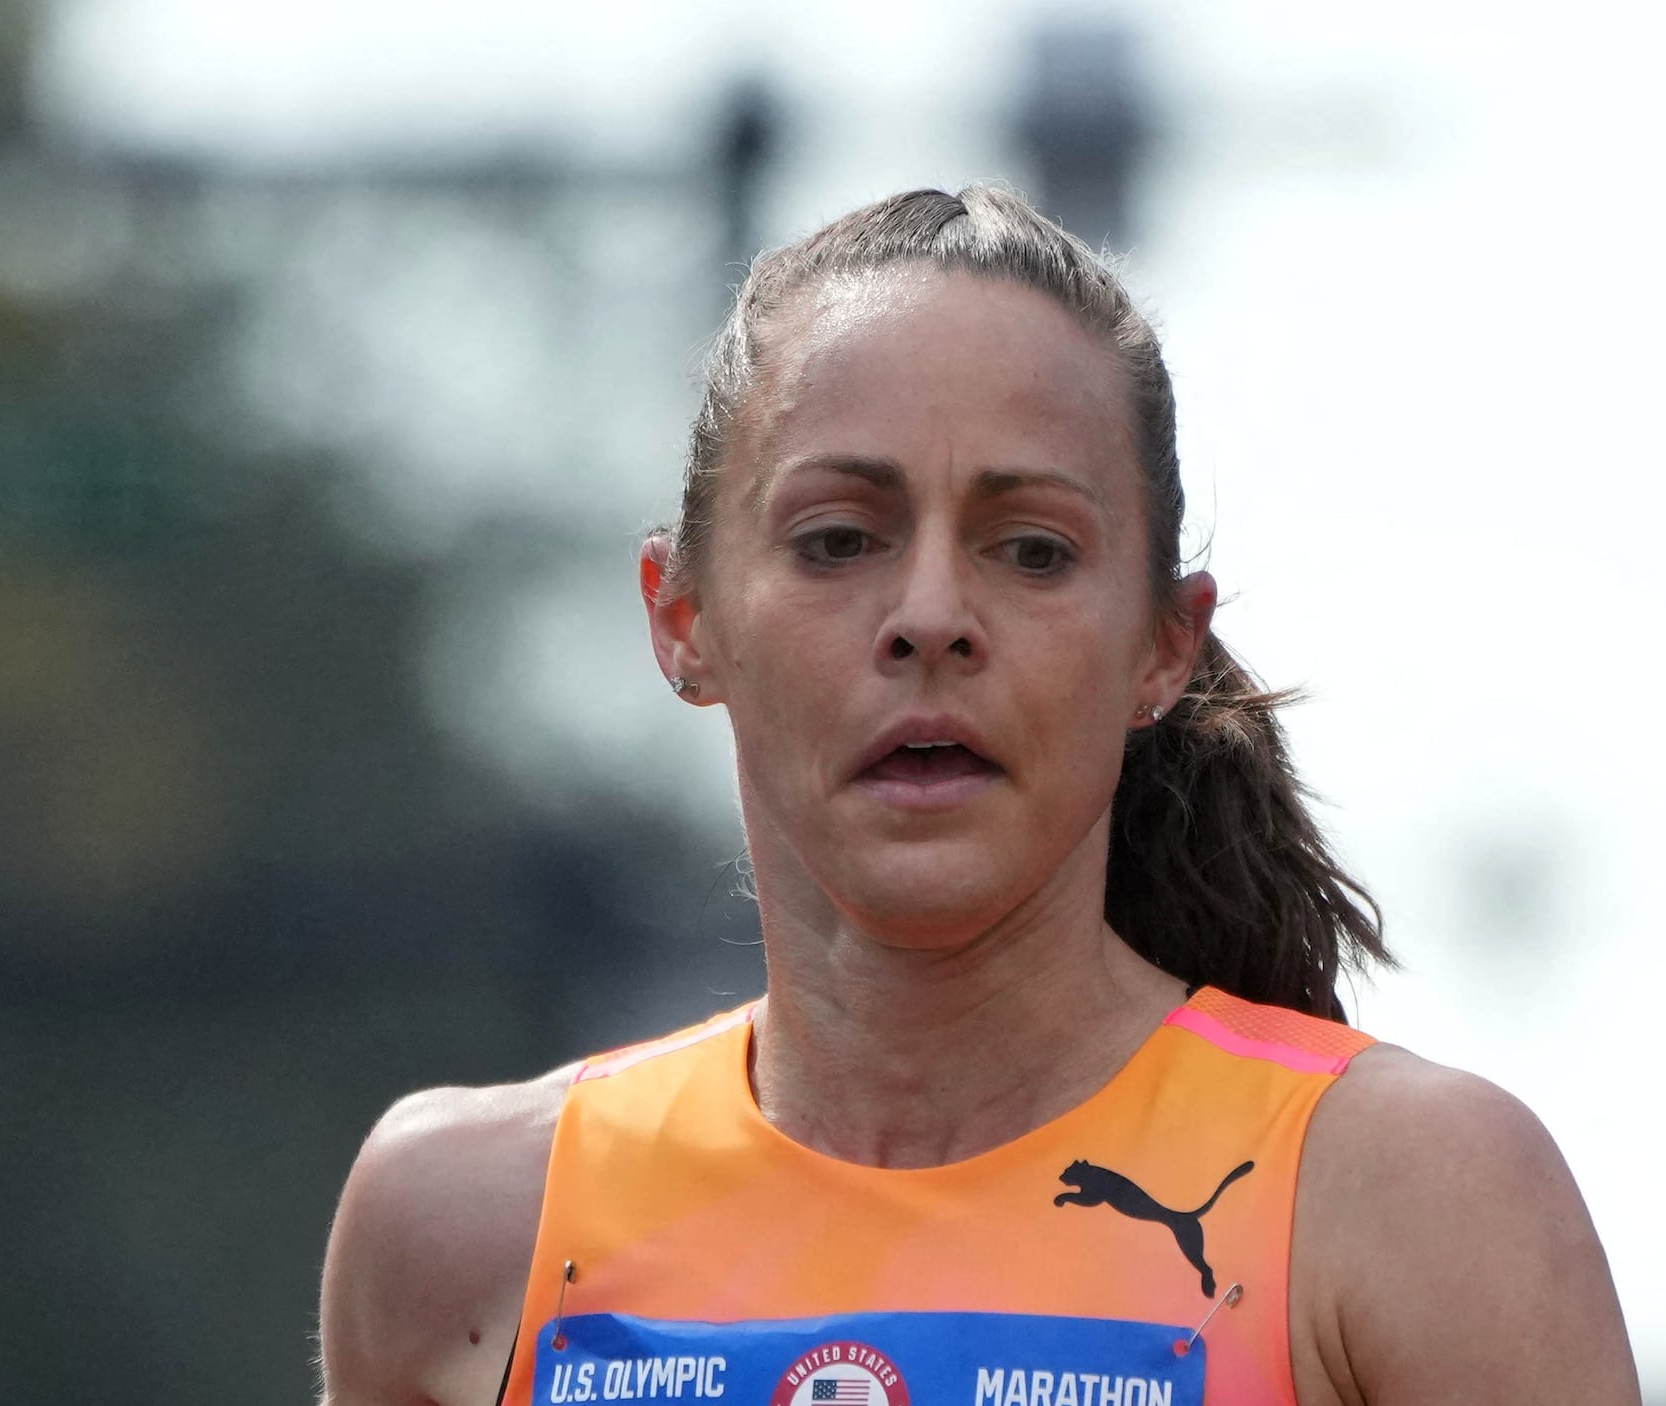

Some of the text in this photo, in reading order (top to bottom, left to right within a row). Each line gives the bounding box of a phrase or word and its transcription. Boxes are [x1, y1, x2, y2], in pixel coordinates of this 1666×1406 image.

[550, 1356, 727, 1404] U.S. OLYMPIC
[787, 1346, 898, 1387] UNITED STATES
